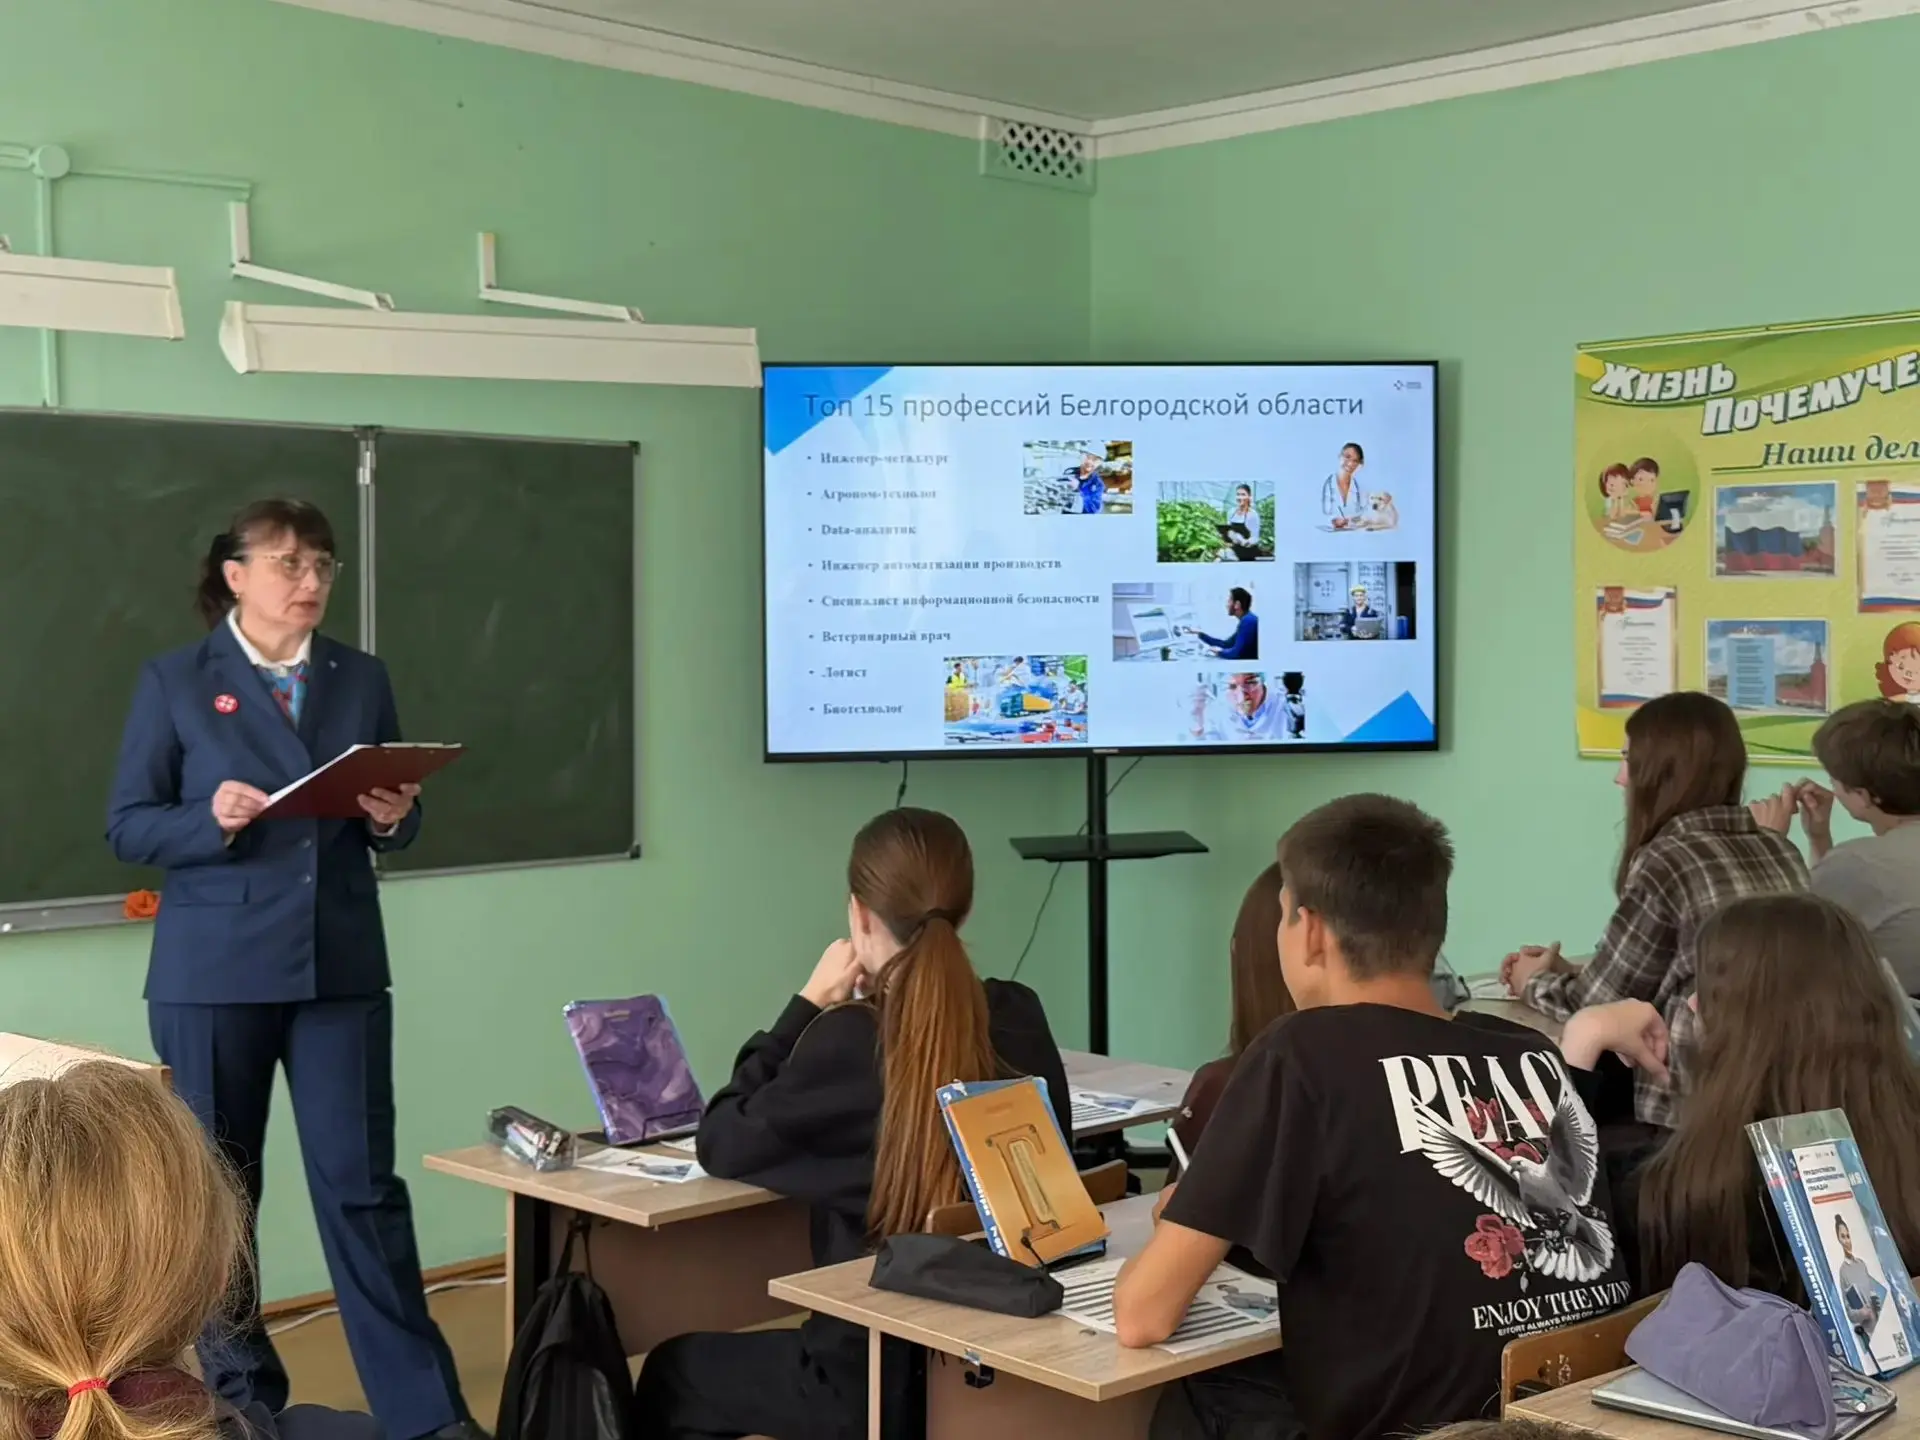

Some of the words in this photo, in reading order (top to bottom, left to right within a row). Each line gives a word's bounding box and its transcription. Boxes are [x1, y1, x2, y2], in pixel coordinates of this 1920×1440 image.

[804, 394, 853, 417] Топ
[864, 394, 893, 417] 15
[903, 393, 1050, 422] профессий
[1060, 393, 1248, 421] Белгородской
[1258, 392, 1363, 415] области
[820, 452, 948, 466] Инженер-металлург
[1761, 442, 1855, 466] Наши
[820, 489, 936, 502] Агроном-технолог
[821, 524, 916, 535] Data-аналитик
[822, 560, 880, 573] Инженер
[882, 560, 979, 571] автоматизации
[983, 559, 1062, 572] производств
[822, 595, 899, 607] Специалист
[902, 592, 1014, 608] информационной
[1017, 592, 1099, 605] безопасности
[822, 630, 917, 644] Ветеринарный
[920, 630, 951, 643] врач
[822, 667, 867, 679] Логист
[822, 703, 902, 715] Биотехнолог
[1472, 1296, 1541, 1329] ENJOY
[1545, 1287, 1592, 1316] THE
